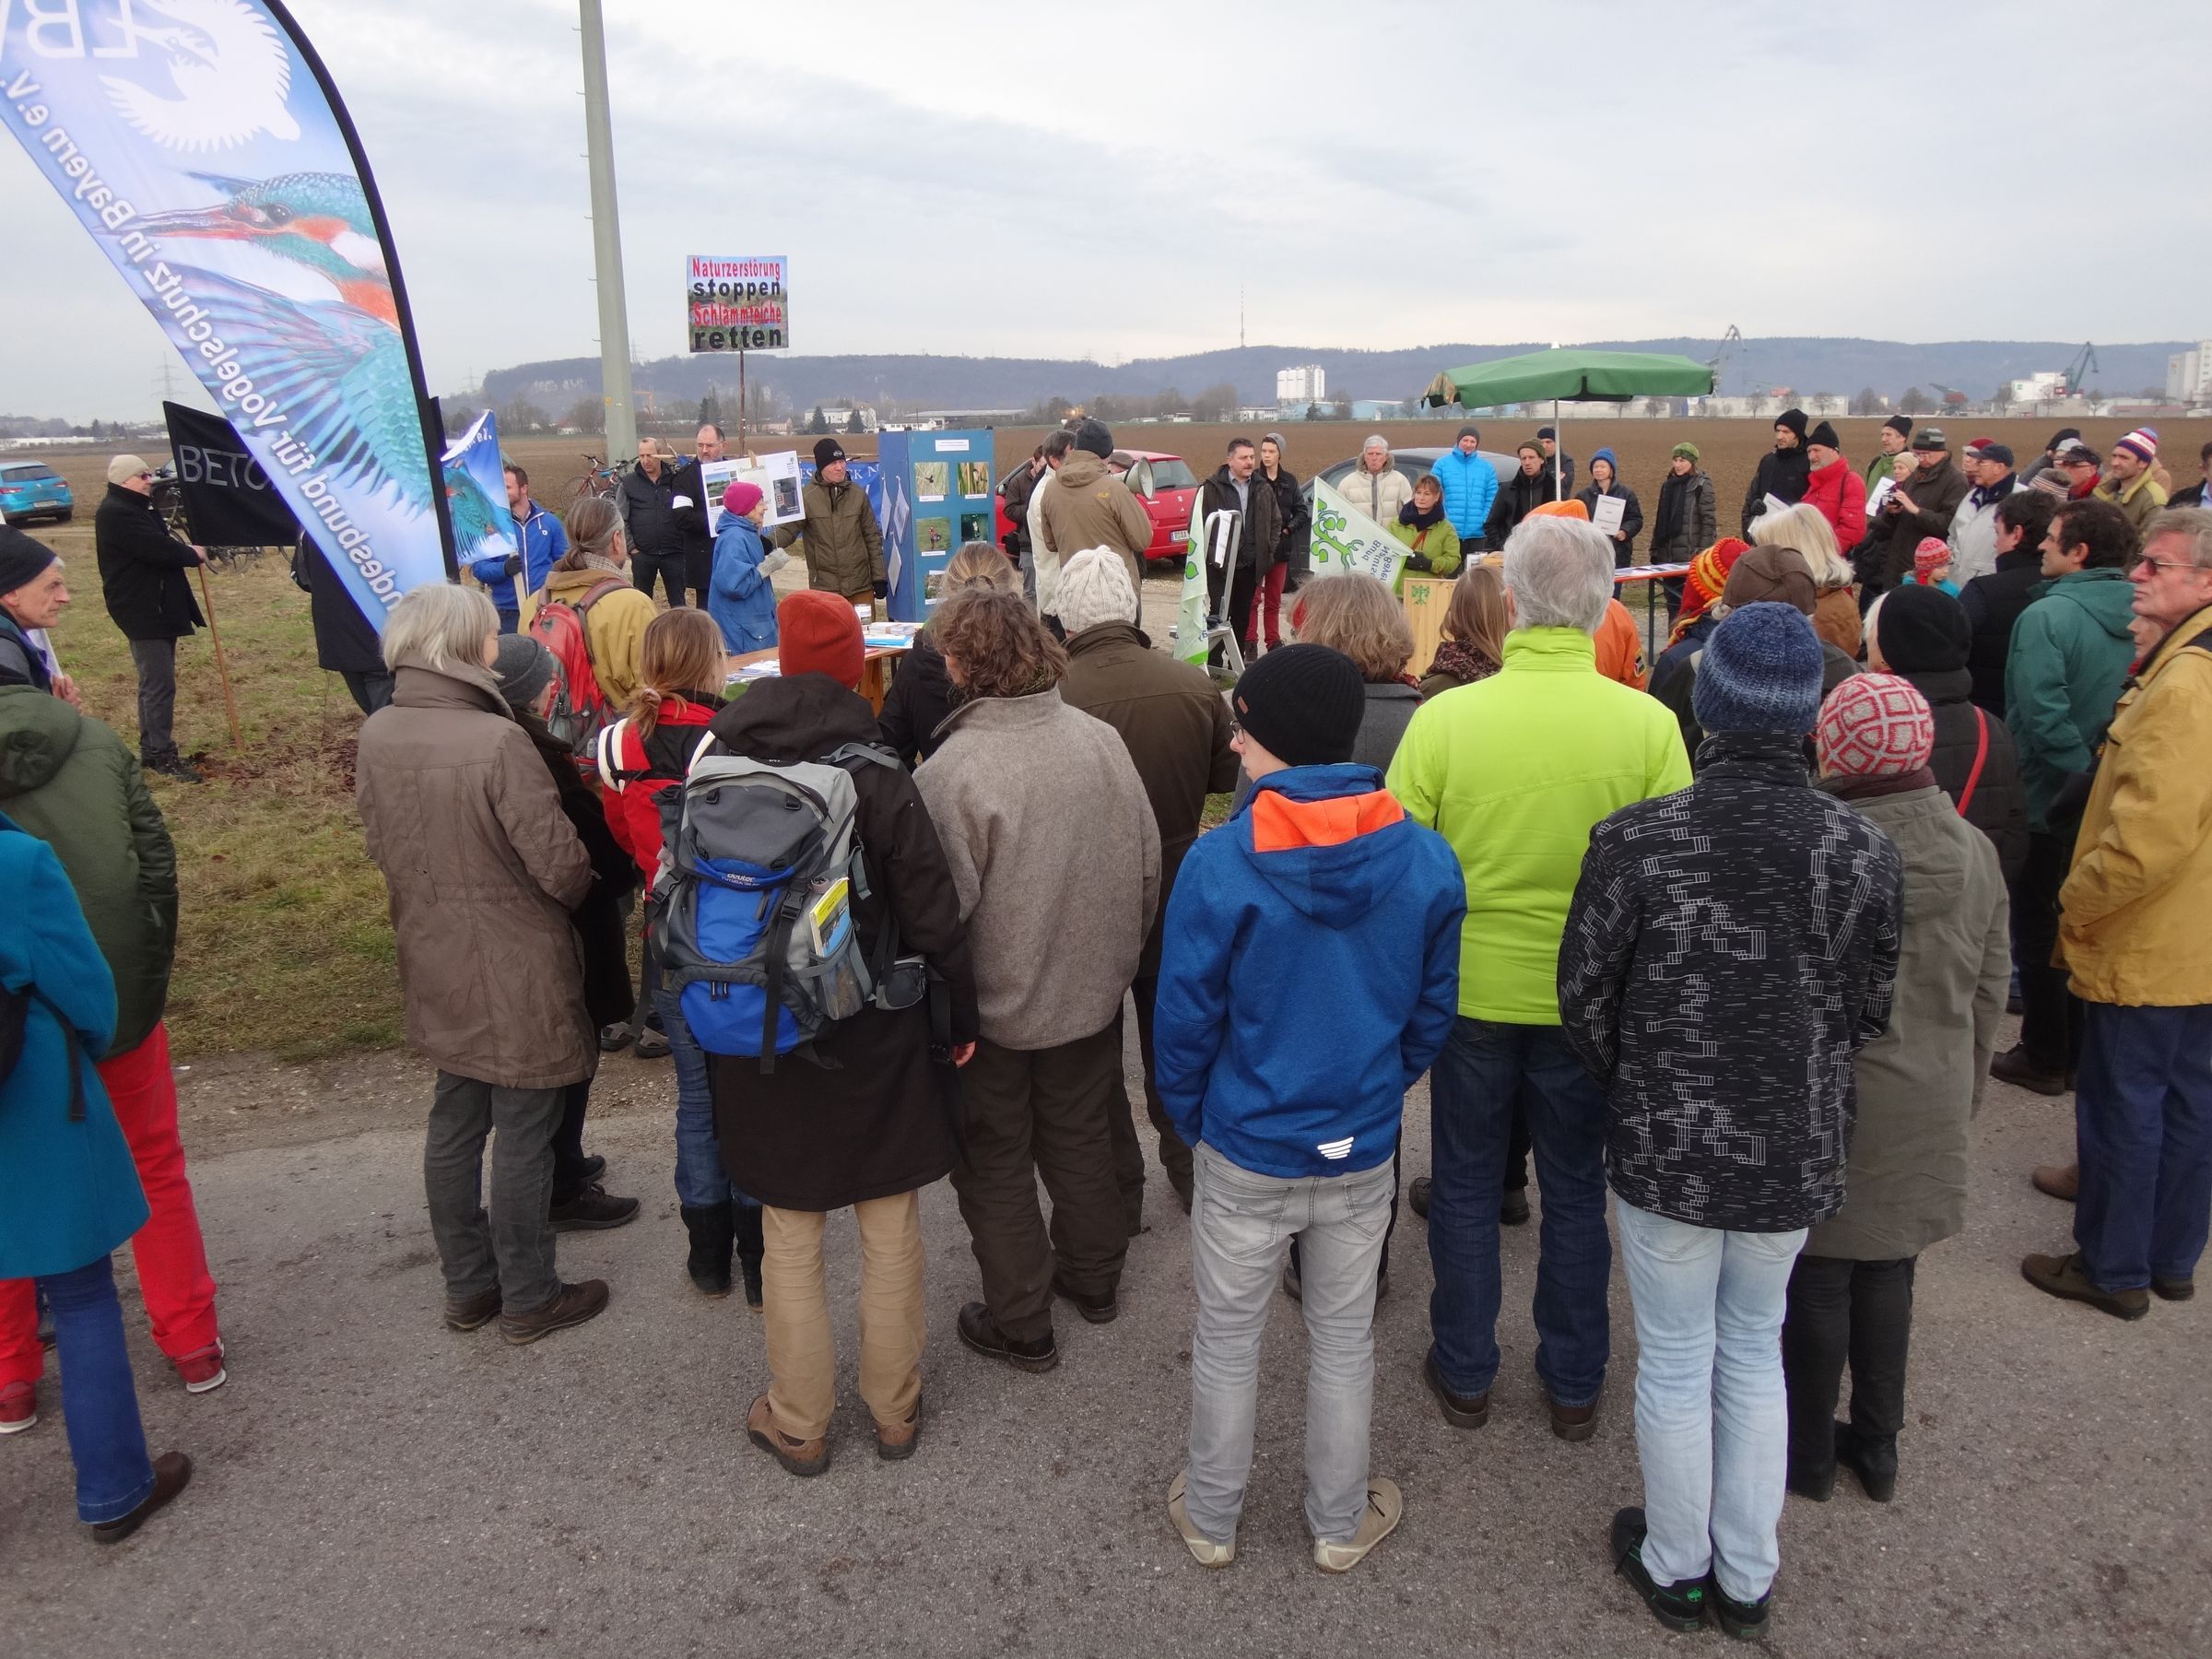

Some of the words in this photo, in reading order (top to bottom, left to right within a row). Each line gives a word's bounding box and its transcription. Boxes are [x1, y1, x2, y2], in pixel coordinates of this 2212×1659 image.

[692, 257, 781, 281] Naturzerstörung
[693, 278, 781, 300] stoppen
[694, 325, 782, 349] retten
[179, 444, 275, 491] BETO
